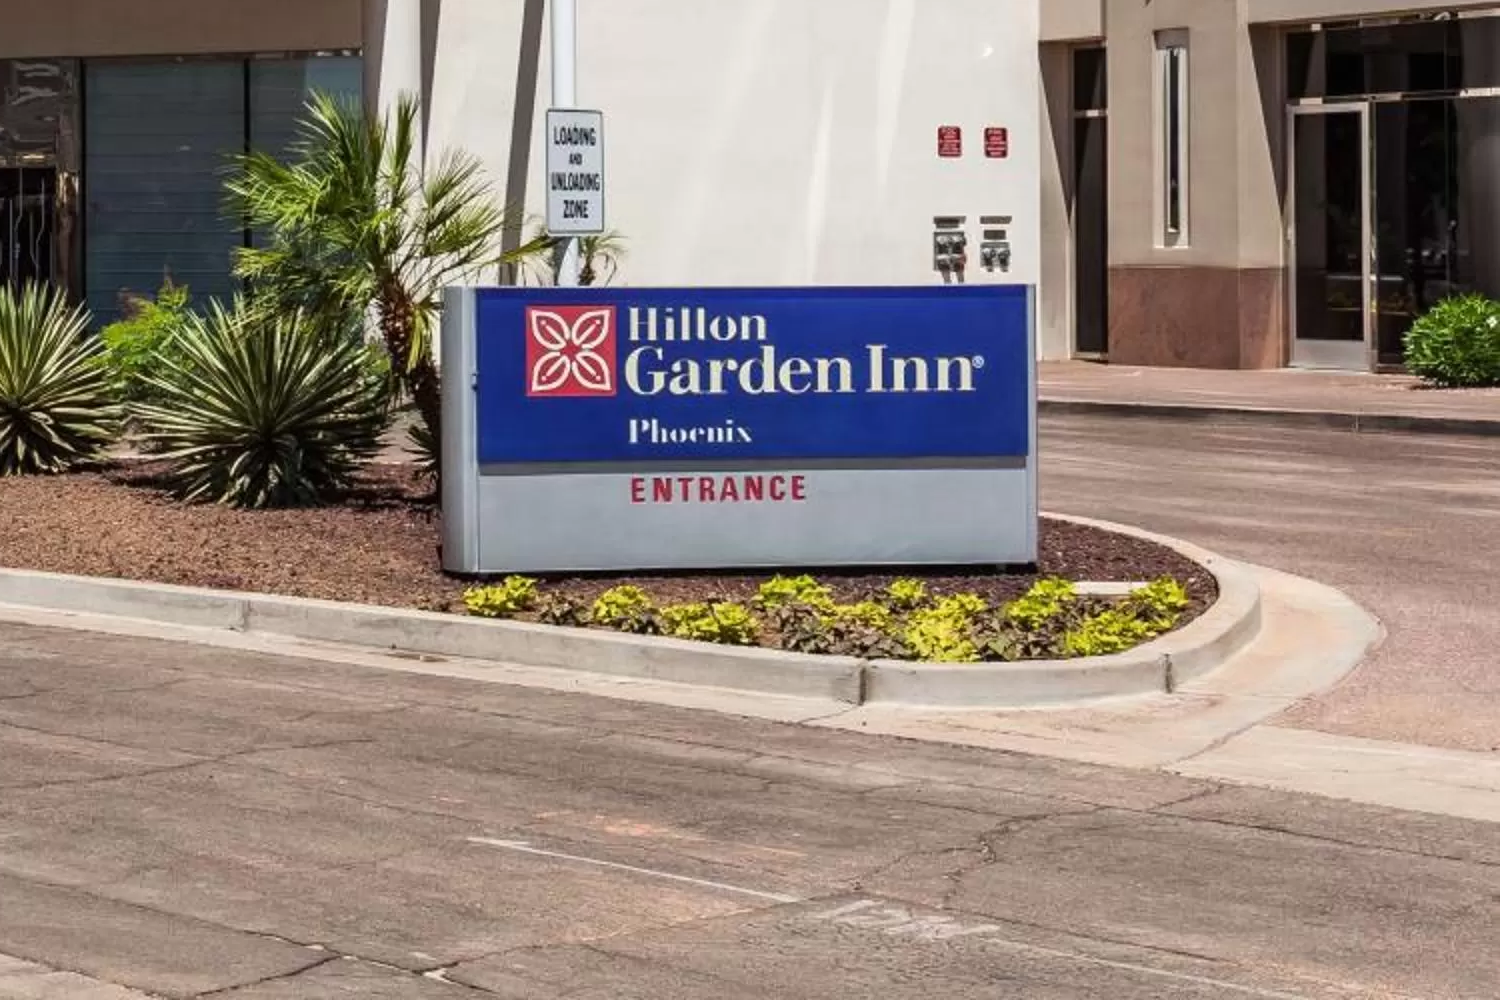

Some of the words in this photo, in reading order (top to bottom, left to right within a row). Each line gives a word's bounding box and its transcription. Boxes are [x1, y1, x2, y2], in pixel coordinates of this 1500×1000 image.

[553, 126, 596, 146] LOADING
[568, 153, 583, 165] AND
[551, 172, 600, 191] UNLOADING
[563, 199, 589, 219] ZONE
[624, 345, 856, 396] Garden
[628, 418, 753, 444] Phoenix
[630, 475, 807, 503] ENTRANCE
